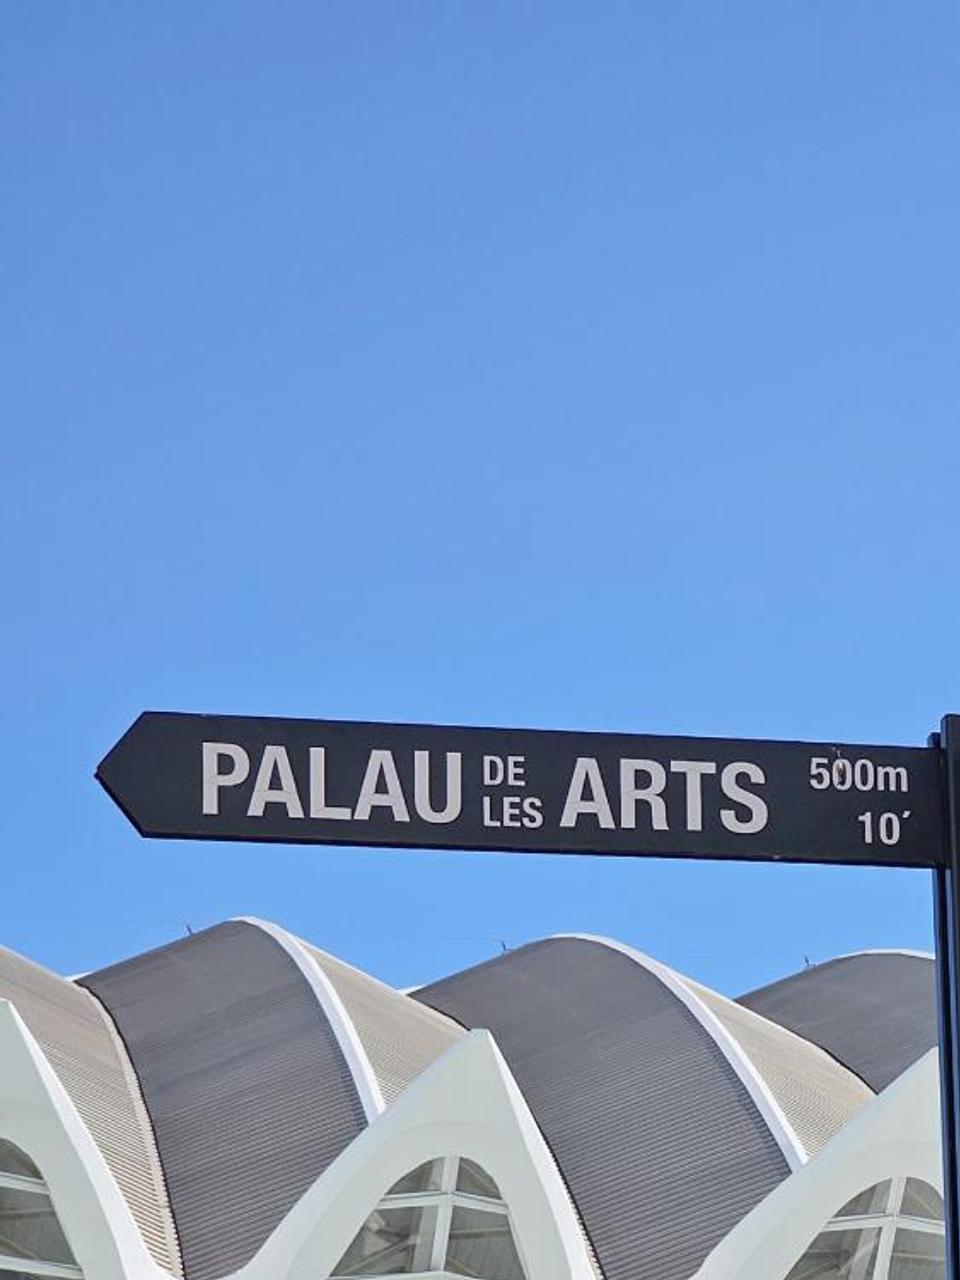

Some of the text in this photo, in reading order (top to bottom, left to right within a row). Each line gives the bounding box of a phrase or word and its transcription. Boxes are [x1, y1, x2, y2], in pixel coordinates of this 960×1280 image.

[203, 743, 768, 834] PALAU DE LES ARTS
[810, 757, 908, 792] 500m
